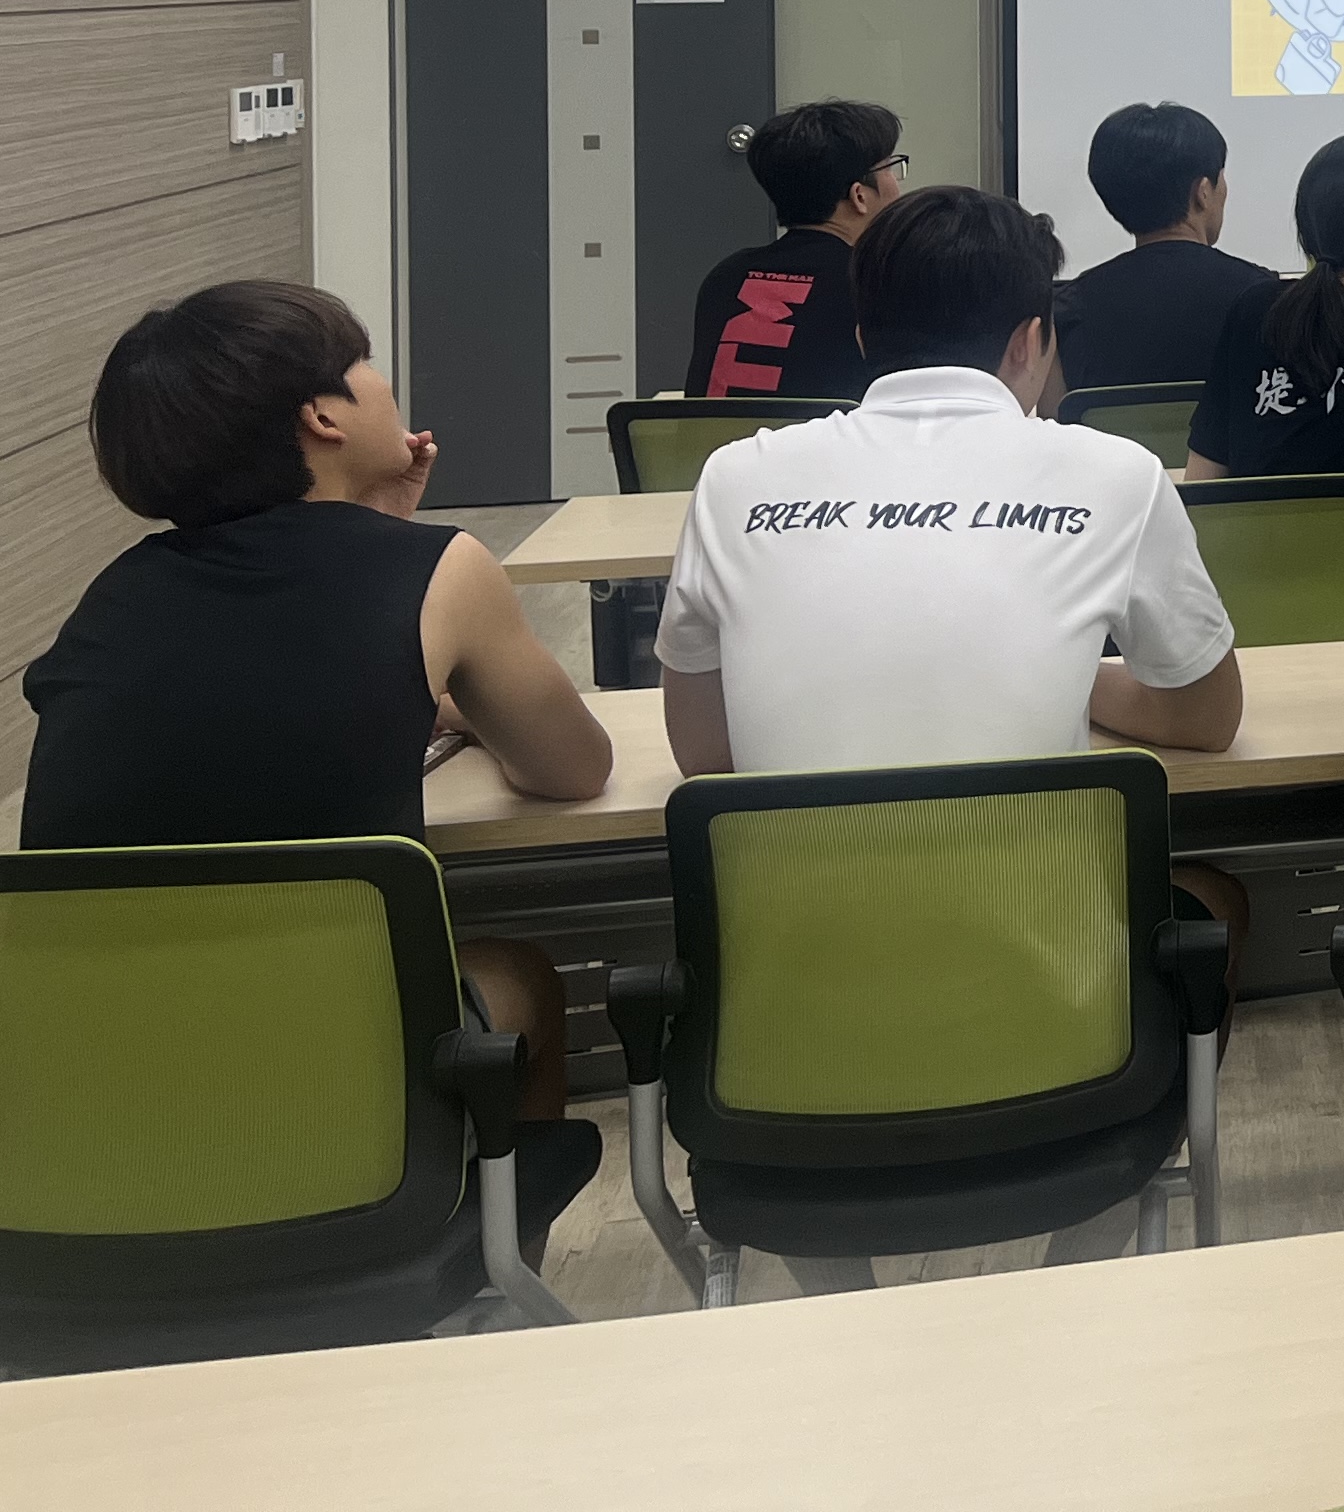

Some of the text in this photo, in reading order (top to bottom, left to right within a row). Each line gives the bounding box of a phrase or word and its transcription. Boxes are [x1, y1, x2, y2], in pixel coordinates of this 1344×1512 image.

[744, 501, 1092, 535] BREAK YOUR LIMITS
